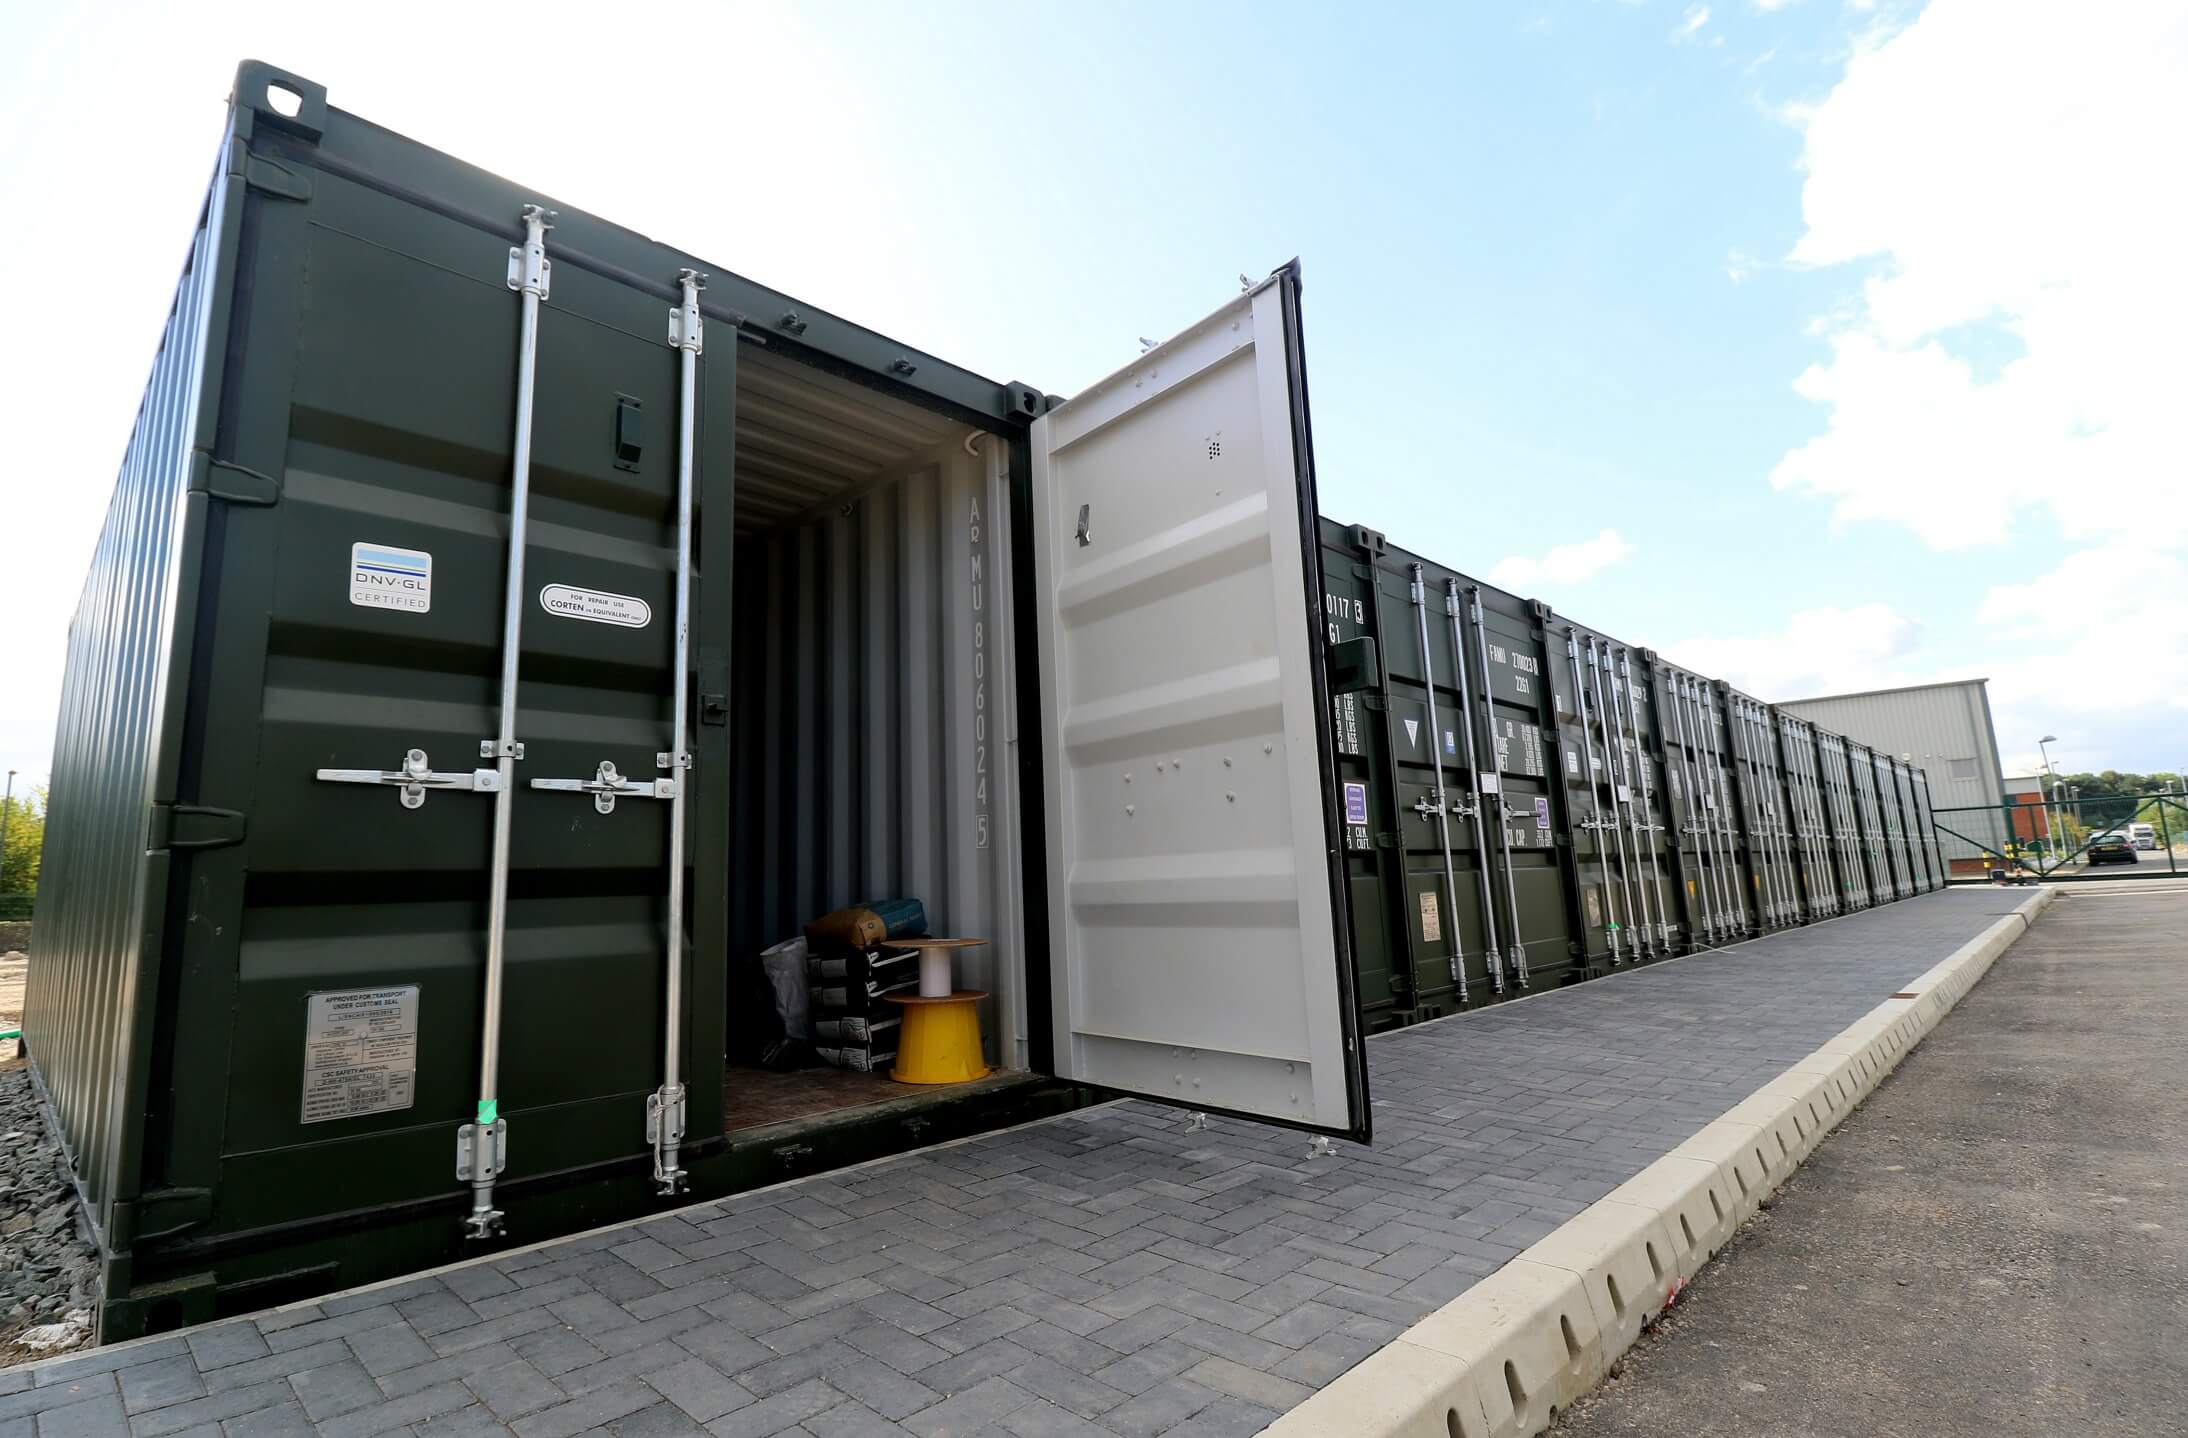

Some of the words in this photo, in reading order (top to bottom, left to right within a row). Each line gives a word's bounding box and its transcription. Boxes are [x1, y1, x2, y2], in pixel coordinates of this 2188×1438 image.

[354, 592, 426, 608] CERTIFIED
[570, 593, 583, 601] FOR
[587, 596, 609, 606] REPAIR
[1326, 593, 1349, 619] 0117
[550, 599, 585, 612] CORTEN
[592, 608, 630, 619] EQUIVALENT
[325, 995, 358, 1003] APPROVED
[371, 990, 407, 999] TRANSPORT
[354, 1000, 382, 1008] CUSTOMS
